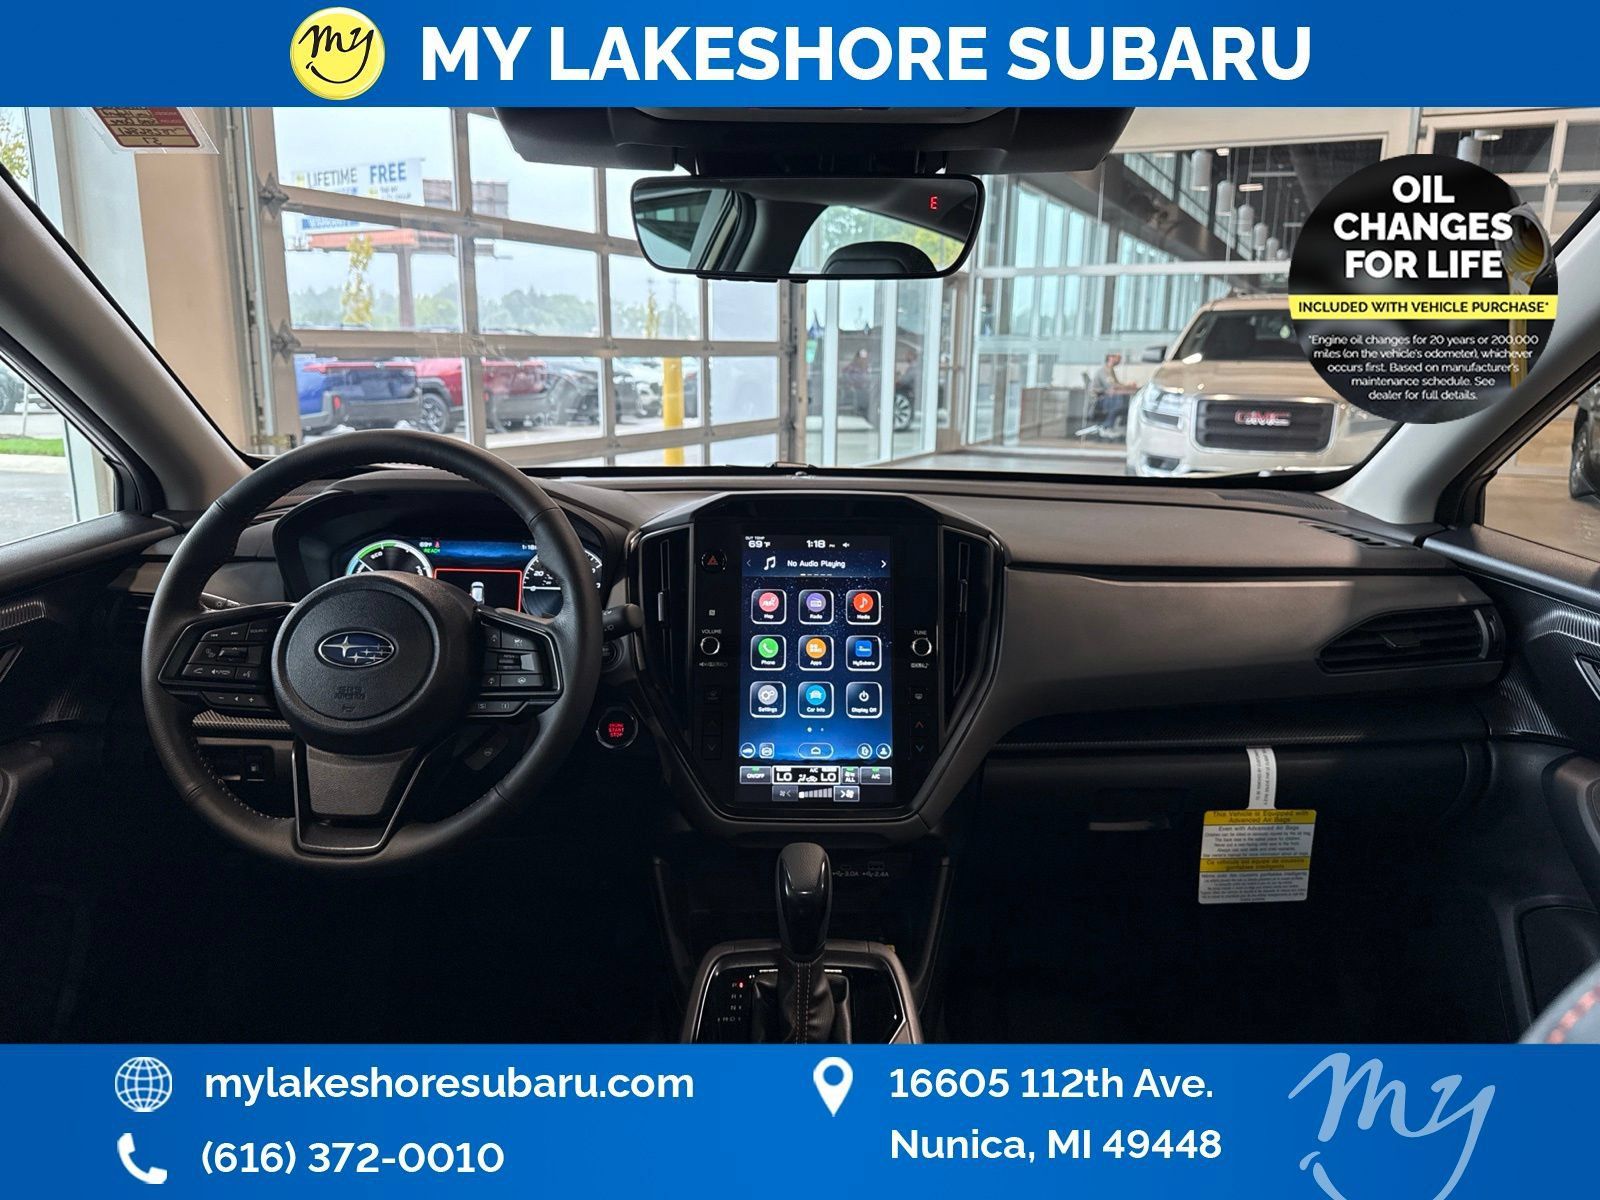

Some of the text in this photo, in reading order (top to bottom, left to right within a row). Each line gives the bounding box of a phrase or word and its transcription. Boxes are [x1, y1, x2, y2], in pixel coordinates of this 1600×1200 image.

[307, 168, 358, 188] LIFETIME
[369, 162, 407, 184] FREE
[930, 196, 938, 210] E
[1234, 409, 1291, 426] GMC
[806, 540, 826, 548] 1:18
[820, 560, 846, 569] Playing
[776, 773, 793, 782] LO
[820, 773, 837, 782] LO
